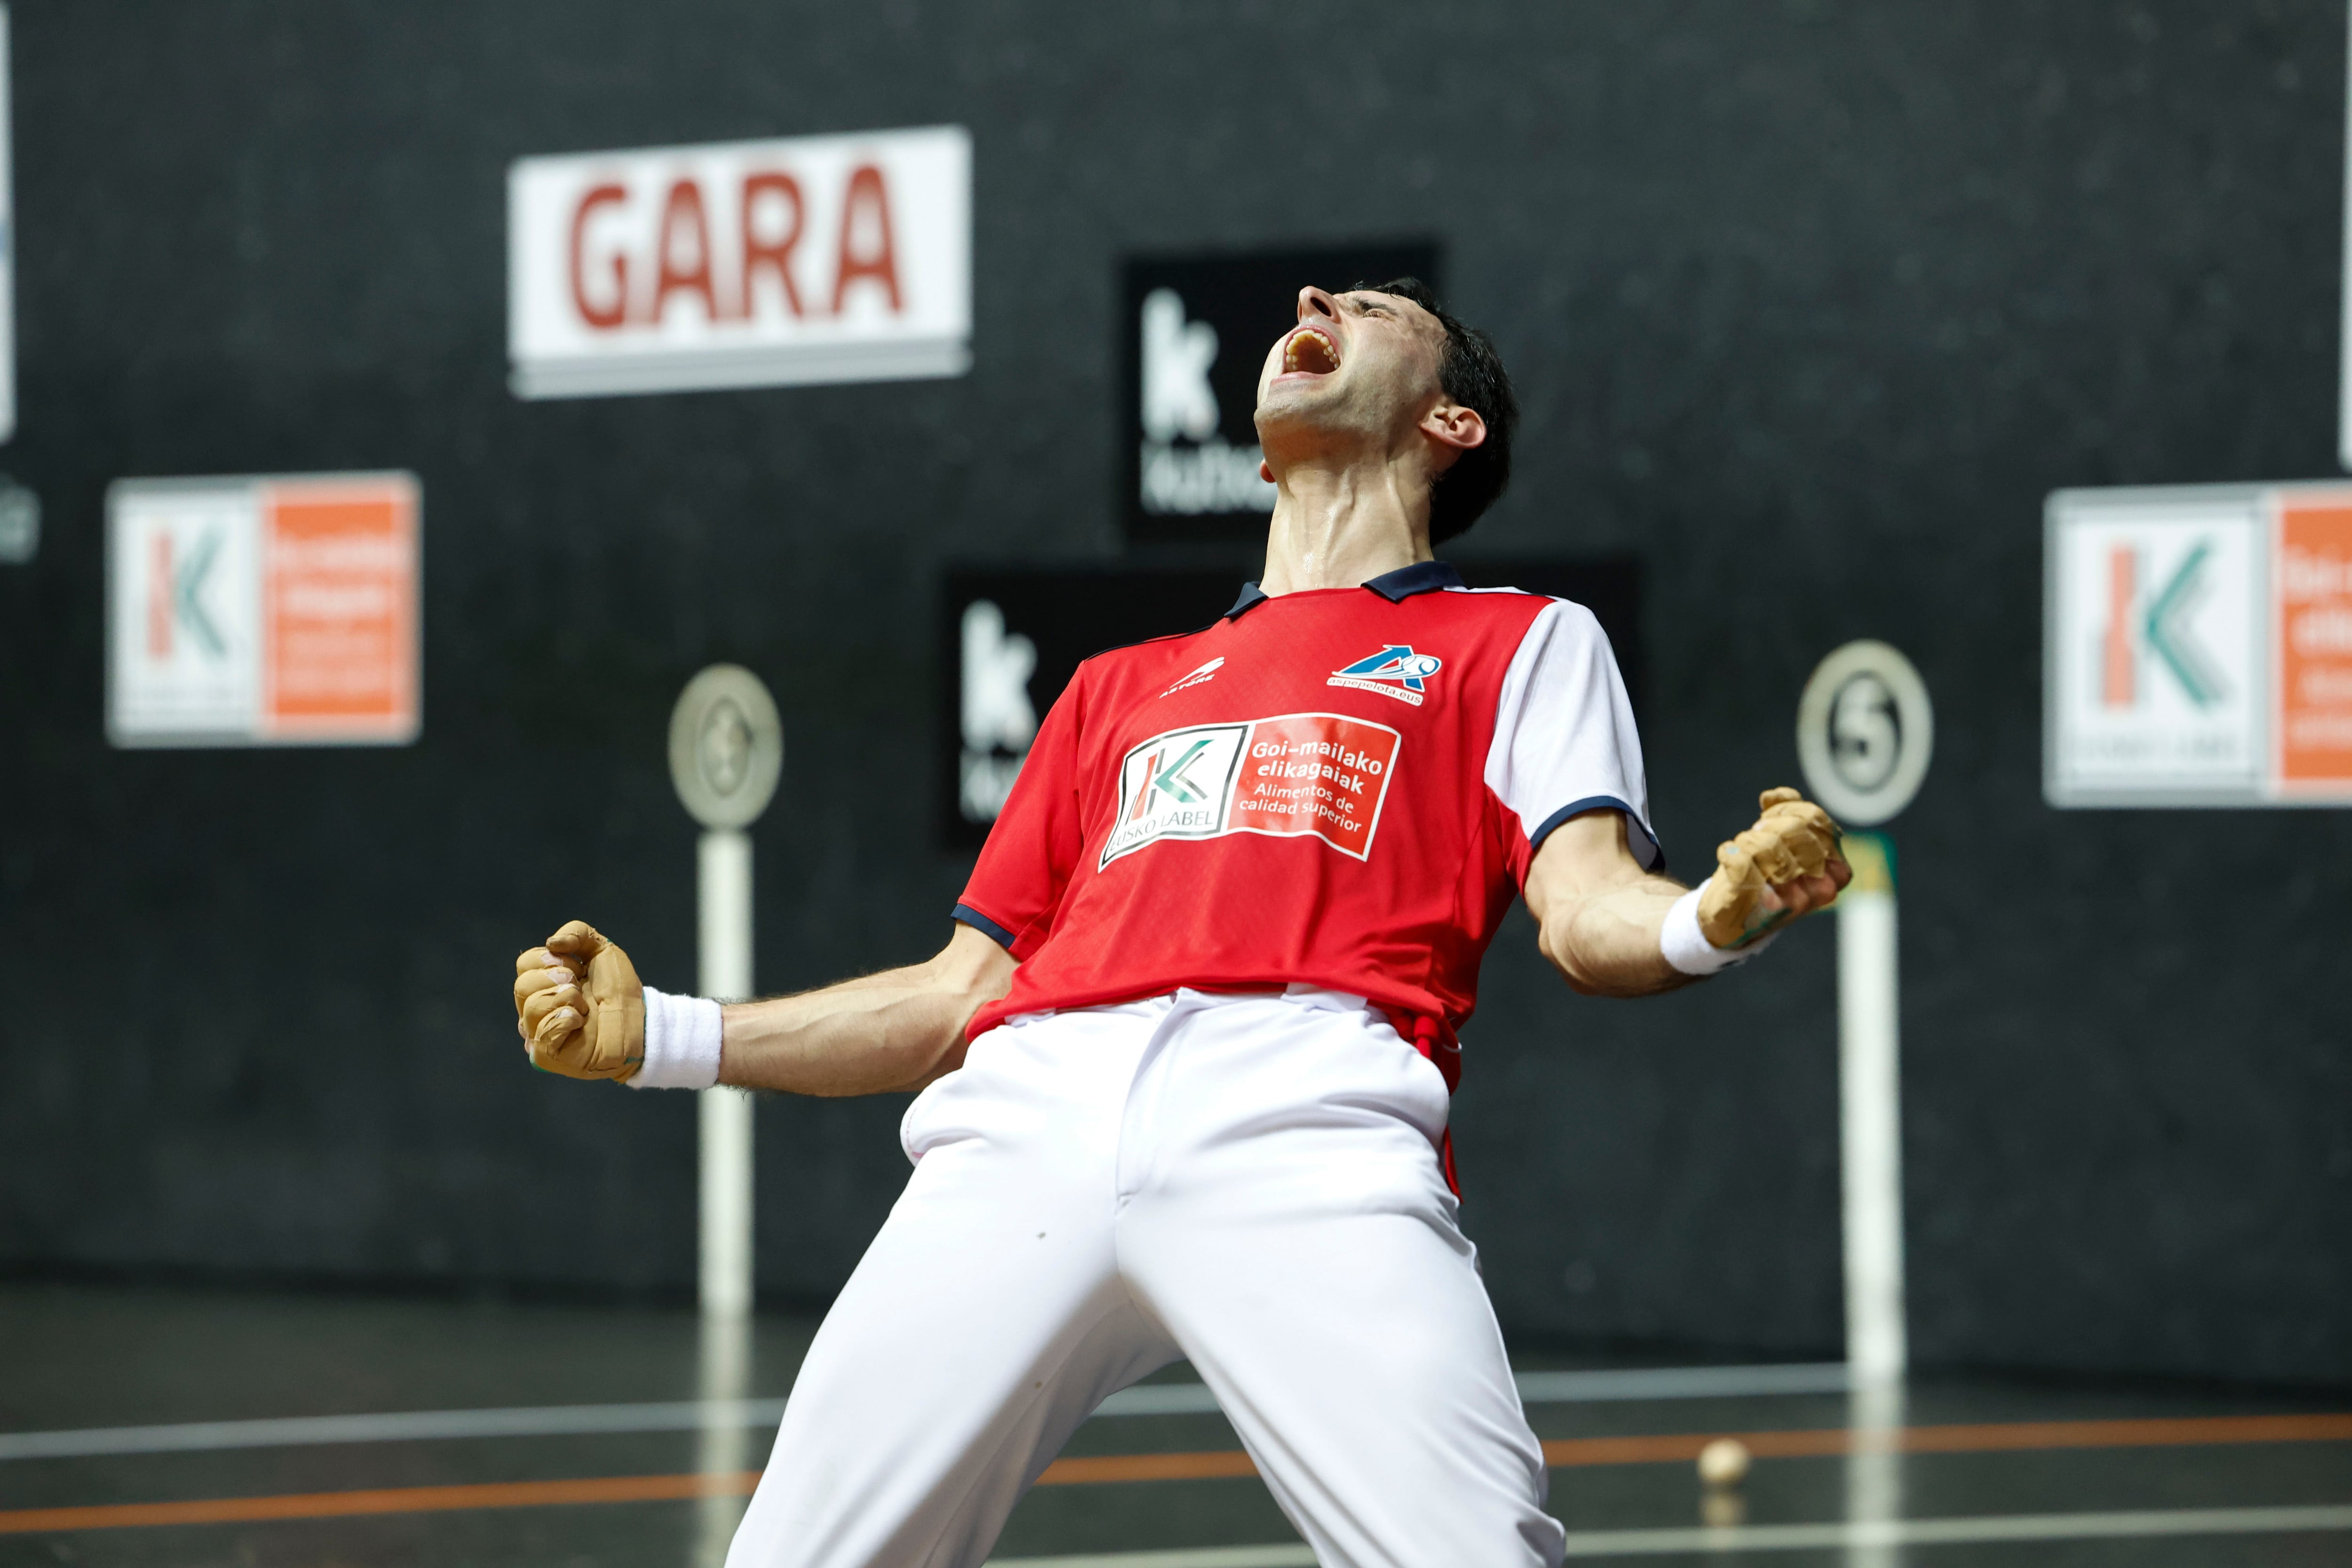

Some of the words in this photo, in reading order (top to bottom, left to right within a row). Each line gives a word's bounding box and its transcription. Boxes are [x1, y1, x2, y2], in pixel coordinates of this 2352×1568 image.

[568, 162, 903, 333] GARA
[1140, 288, 1219, 441] k
[1159, 674, 1215, 699] ASTORE
[1328, 678, 1421, 704] aspepelota.eus
[1252, 740, 1383, 775] Goi-mailako
[1257, 760, 1365, 795] elikagaiak
[1239, 798, 1298, 815] calidad
[1301, 803, 1362, 833] superior
[1254, 782, 1333, 802] Alimentos
[1336, 797, 1354, 814] de
[1110, 819, 1156, 852] EUSKO
[1160, 811, 1213, 827] LABEL
